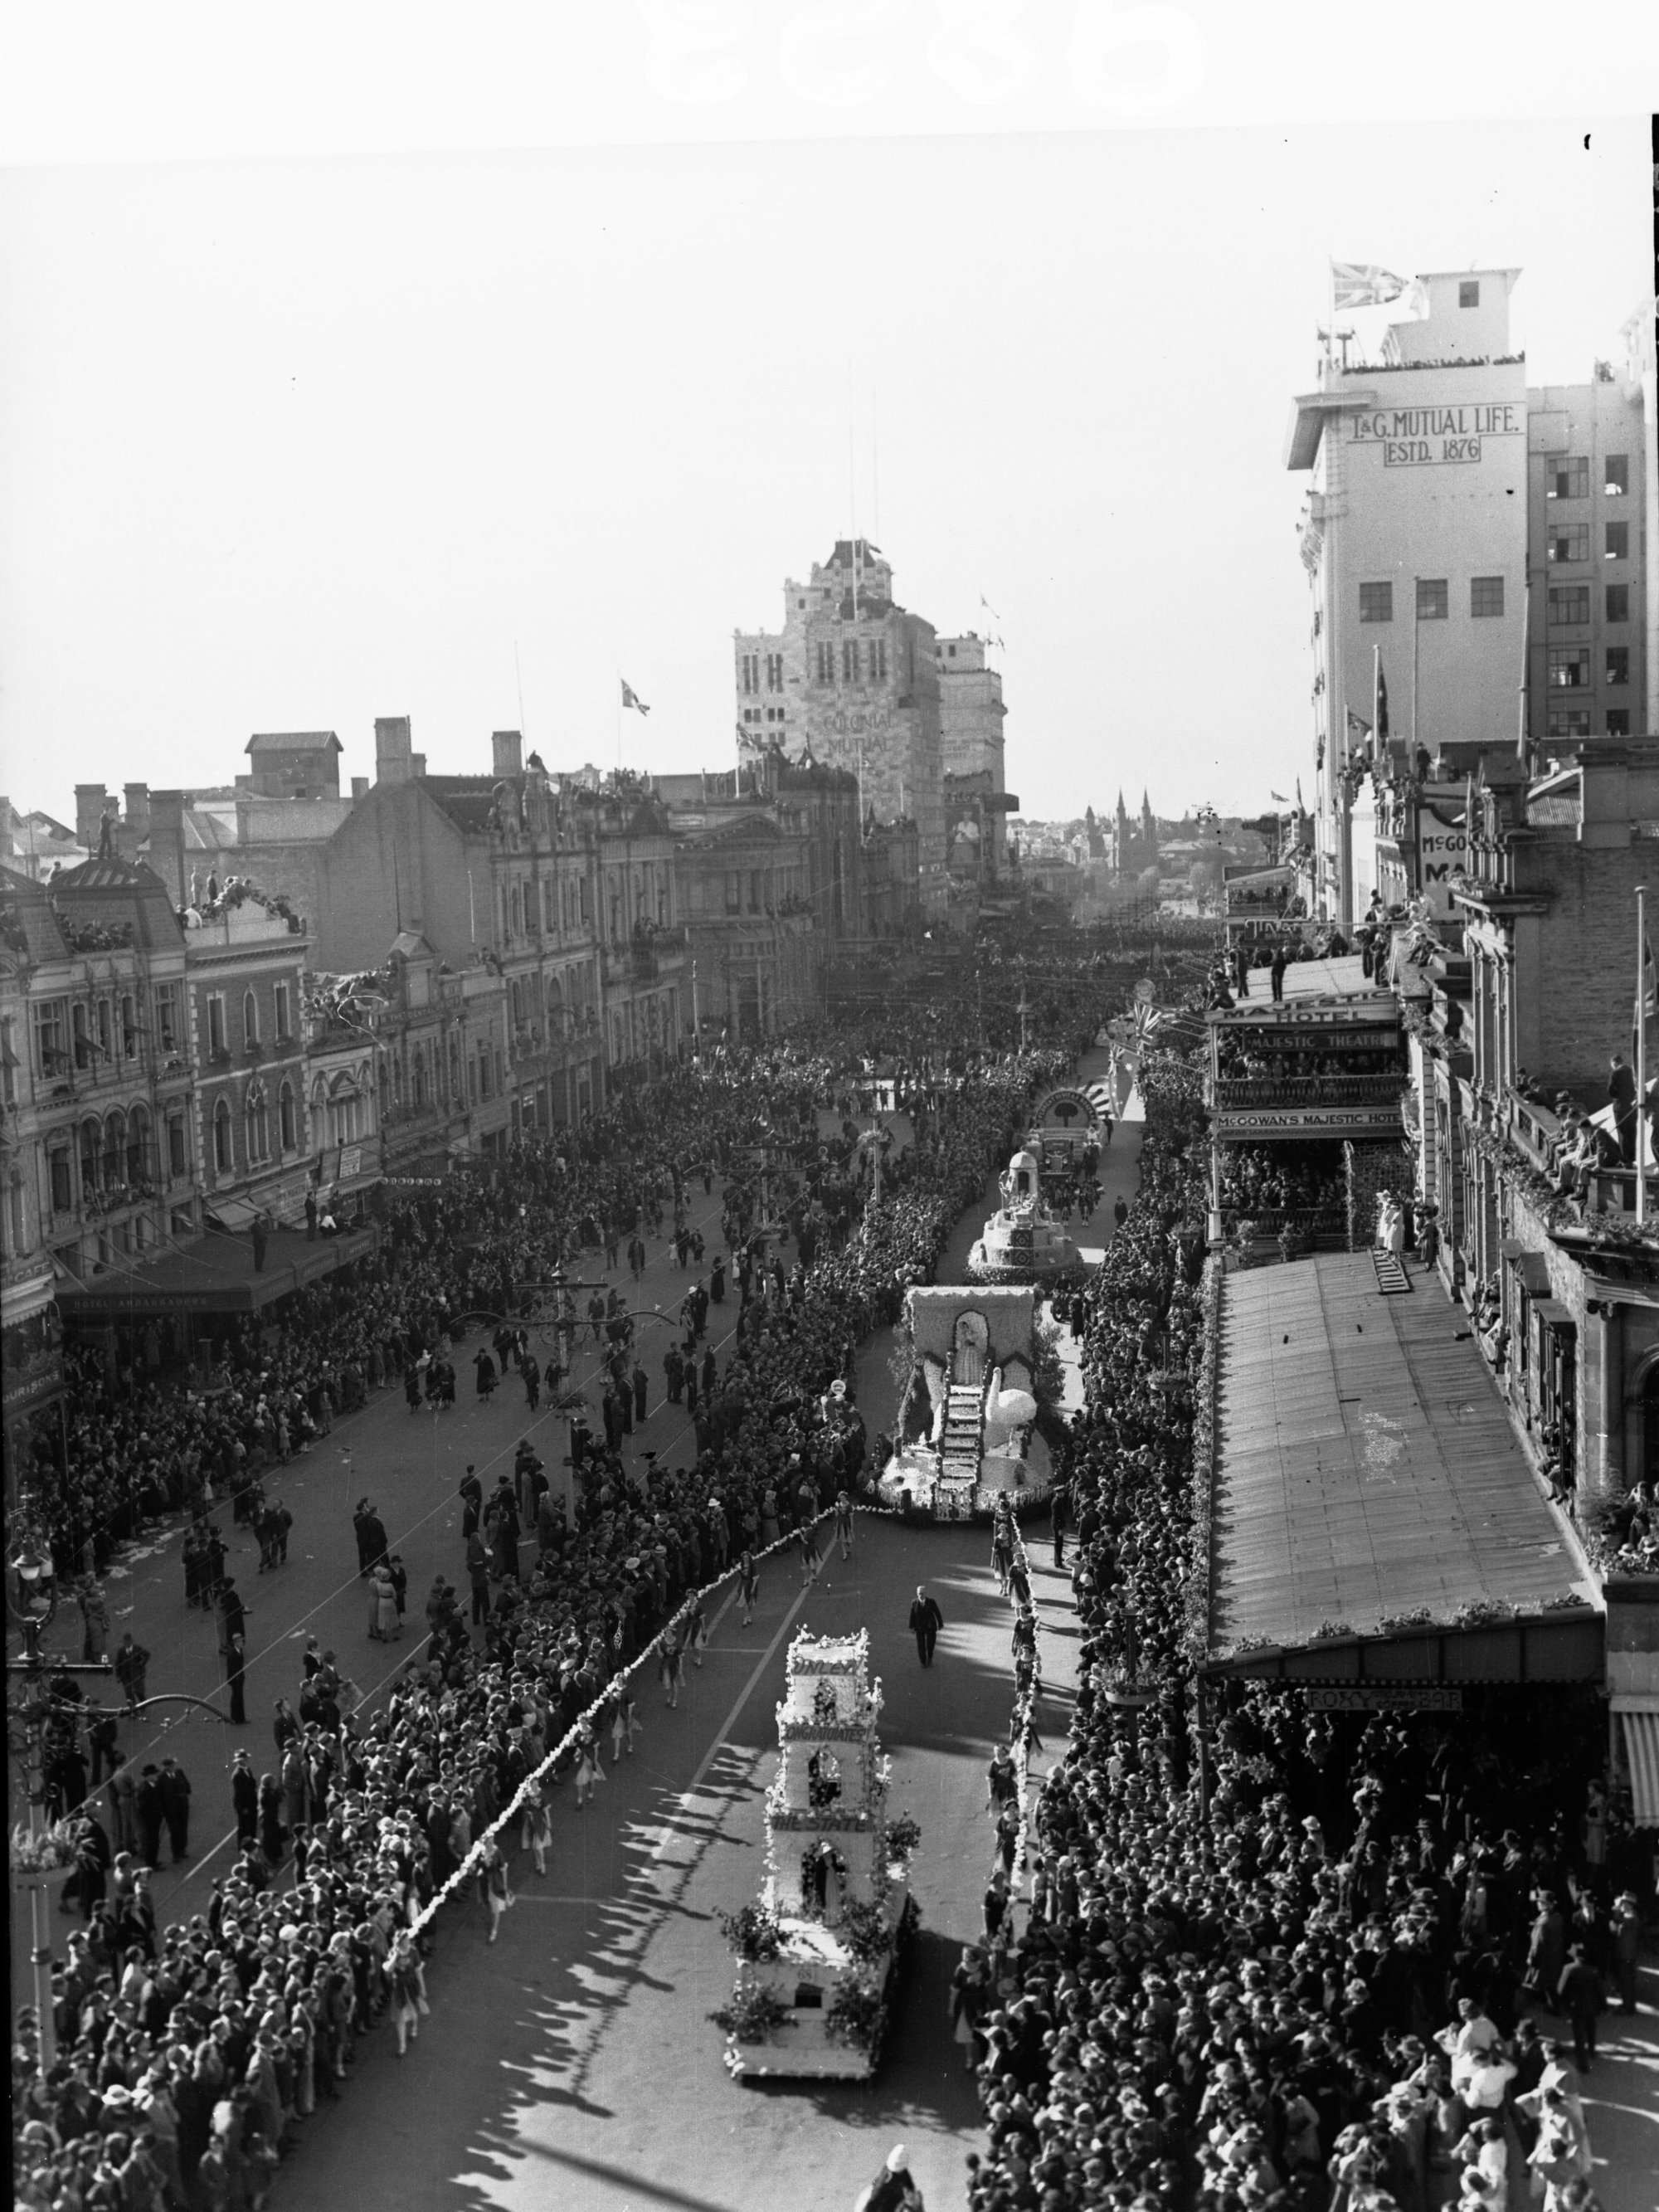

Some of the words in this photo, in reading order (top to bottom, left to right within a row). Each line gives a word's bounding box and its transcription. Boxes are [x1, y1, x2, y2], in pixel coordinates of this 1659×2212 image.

[1393, 409, 1470, 438] MUTUAL
[1475, 407, 1520, 432] LIFE.
[1388, 441, 1433, 462] ESTD.
[1443, 439, 1479, 460] 1876
[827, 737, 891, 753] MUTUAL
[1224, 992, 1392, 1019] MAJESTIC
[1277, 1011, 1367, 1023] HOTEL
[1303, 1113, 1364, 1125] MAJESTIC
[1369, 1113, 1401, 1124] HOTE
[15, 1261, 50, 1284] CAFE
[74, 1299, 109, 1309] HOTEL
[119, 1297, 207, 1308] AMBASSADORS
[793, 1660, 852, 1675] UNLEY
[1310, 1690, 1371, 1708] ROXY
[1418, 1690, 1461, 1709] BAR
[772, 1815, 801, 1831] THE
[805, 1816, 866, 1832] STATE
